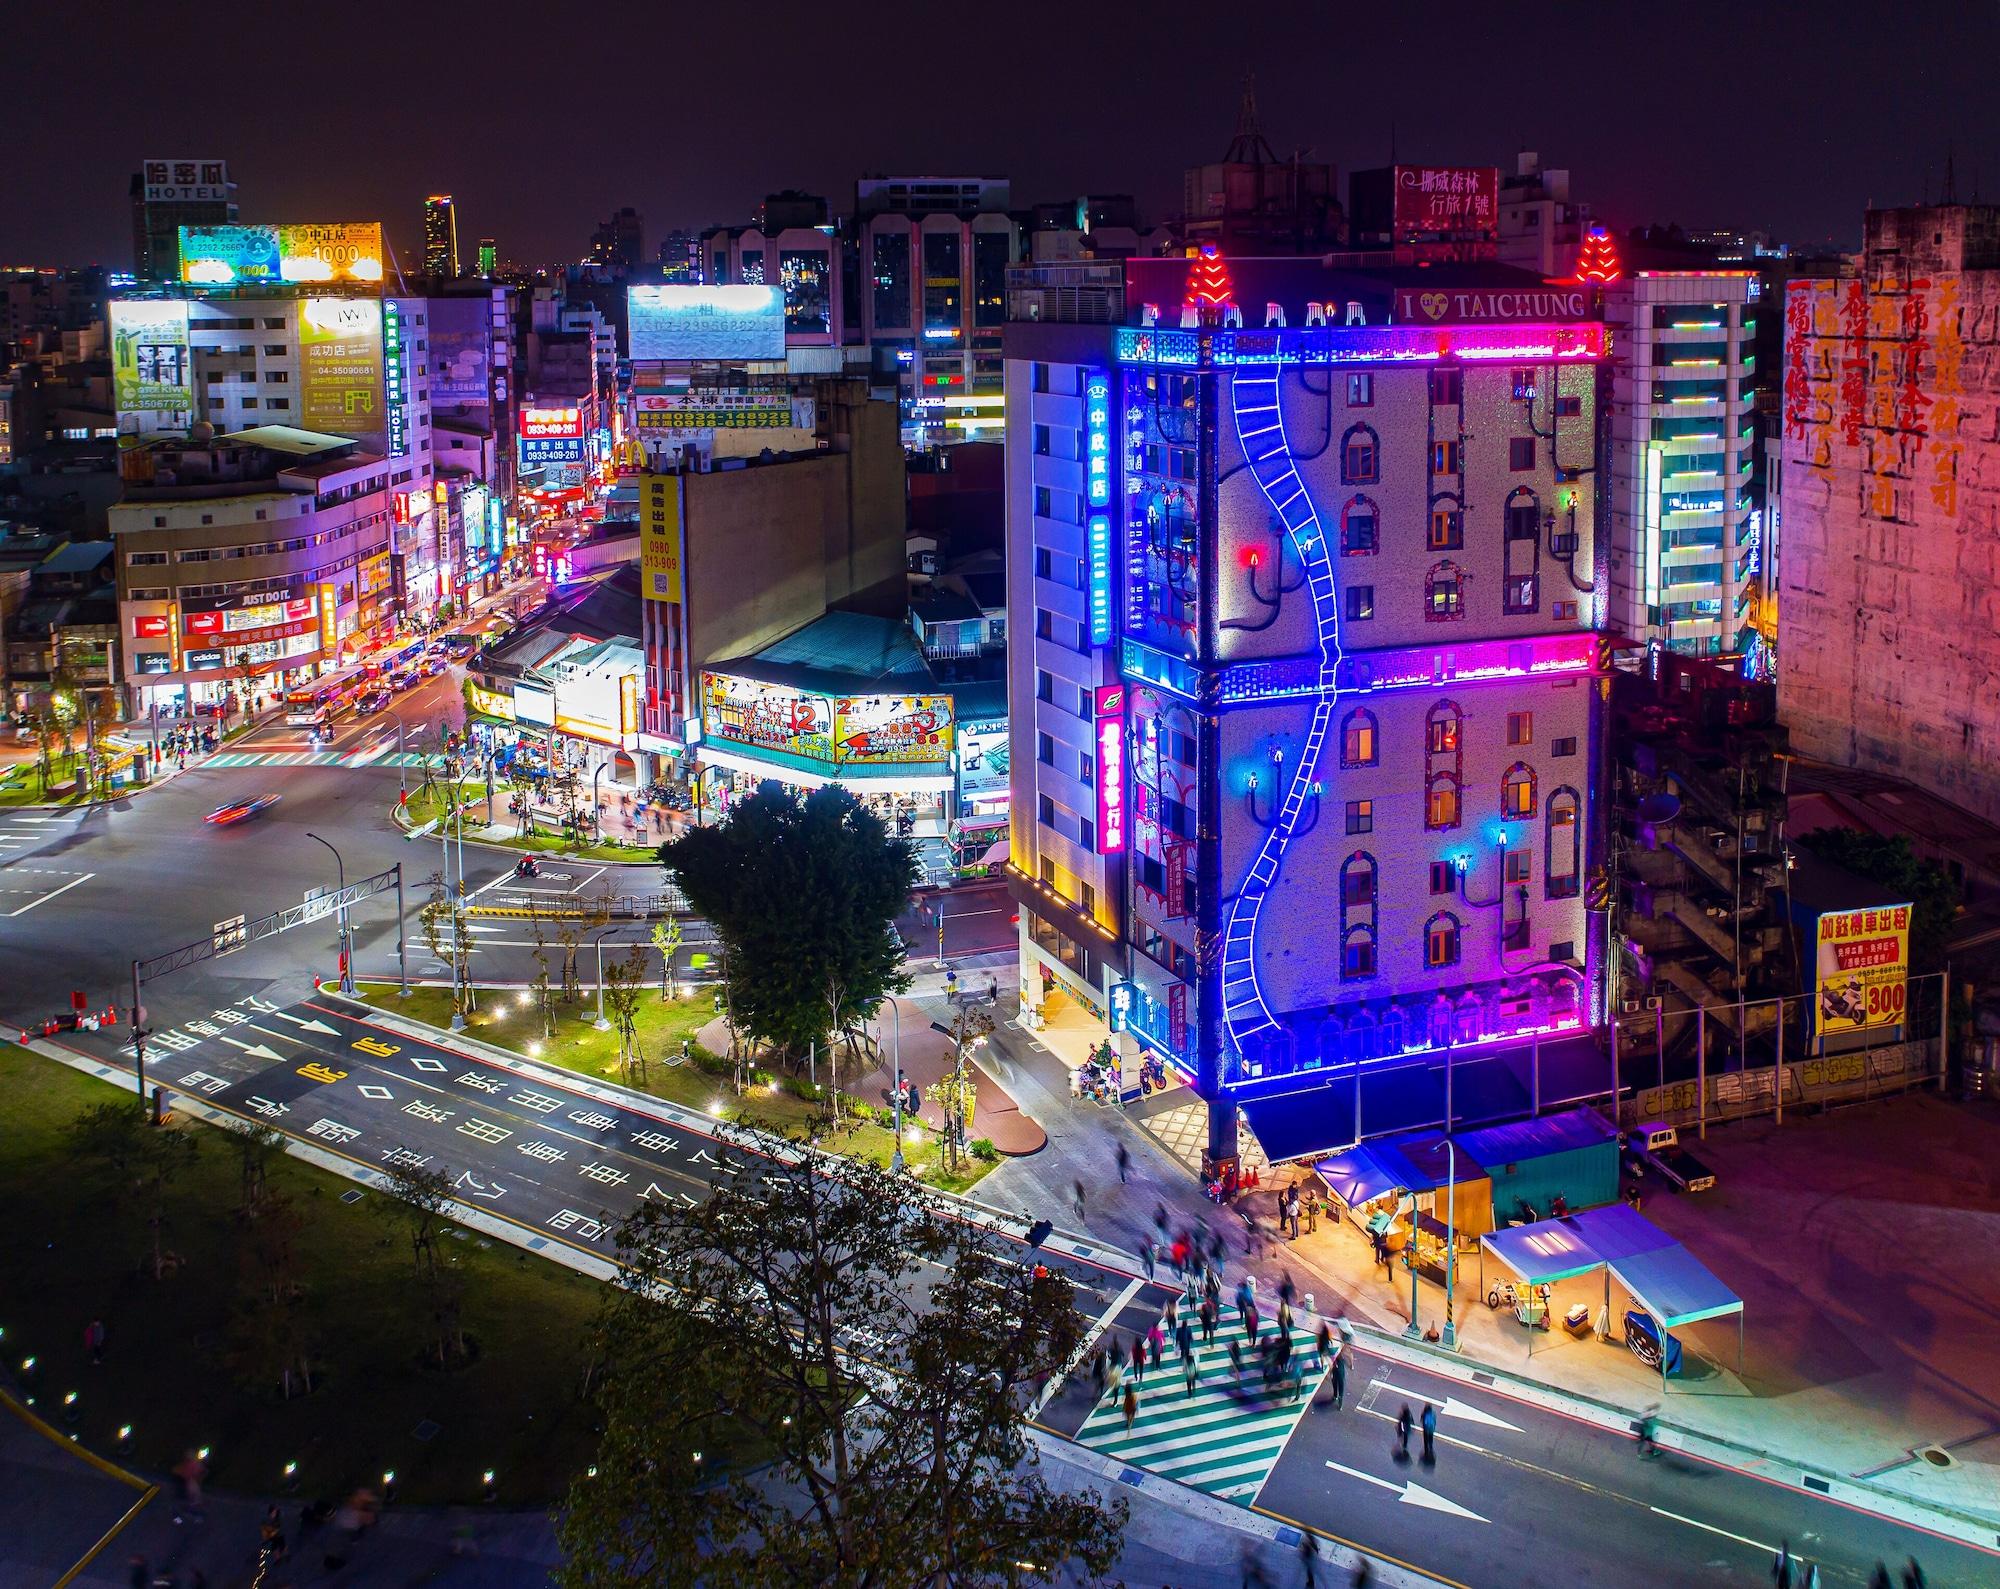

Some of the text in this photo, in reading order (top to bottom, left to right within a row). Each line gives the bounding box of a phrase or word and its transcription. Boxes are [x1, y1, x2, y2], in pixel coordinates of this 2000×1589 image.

[146, 163, 222, 185] 哈密瓜
[148, 187, 224, 199] HOTEL
[309, 229, 347, 241] 中正店
[311, 244, 360, 264] 1000
[1403, 293, 1585, 319] I TAICHUNG
[309, 345, 346, 357] 成功店
[677, 396, 718, 405] 本棟
[391, 409, 401, 450] HOTEL
[527, 424, 577, 434] 0933-409-261
[526, 441, 579, 451] 廣告出租
[527, 451, 579, 461] 0933-409-261
[651, 483, 666, 535] 廣告出租
[649, 540, 670, 554] 0980
[644, 554, 677, 570] 313-909
[242, 594, 265, 606] JUST
[266, 592, 281, 602] DO
[193, 653, 221, 662] adidas
[1868, 984, 1904, 1015] 300
